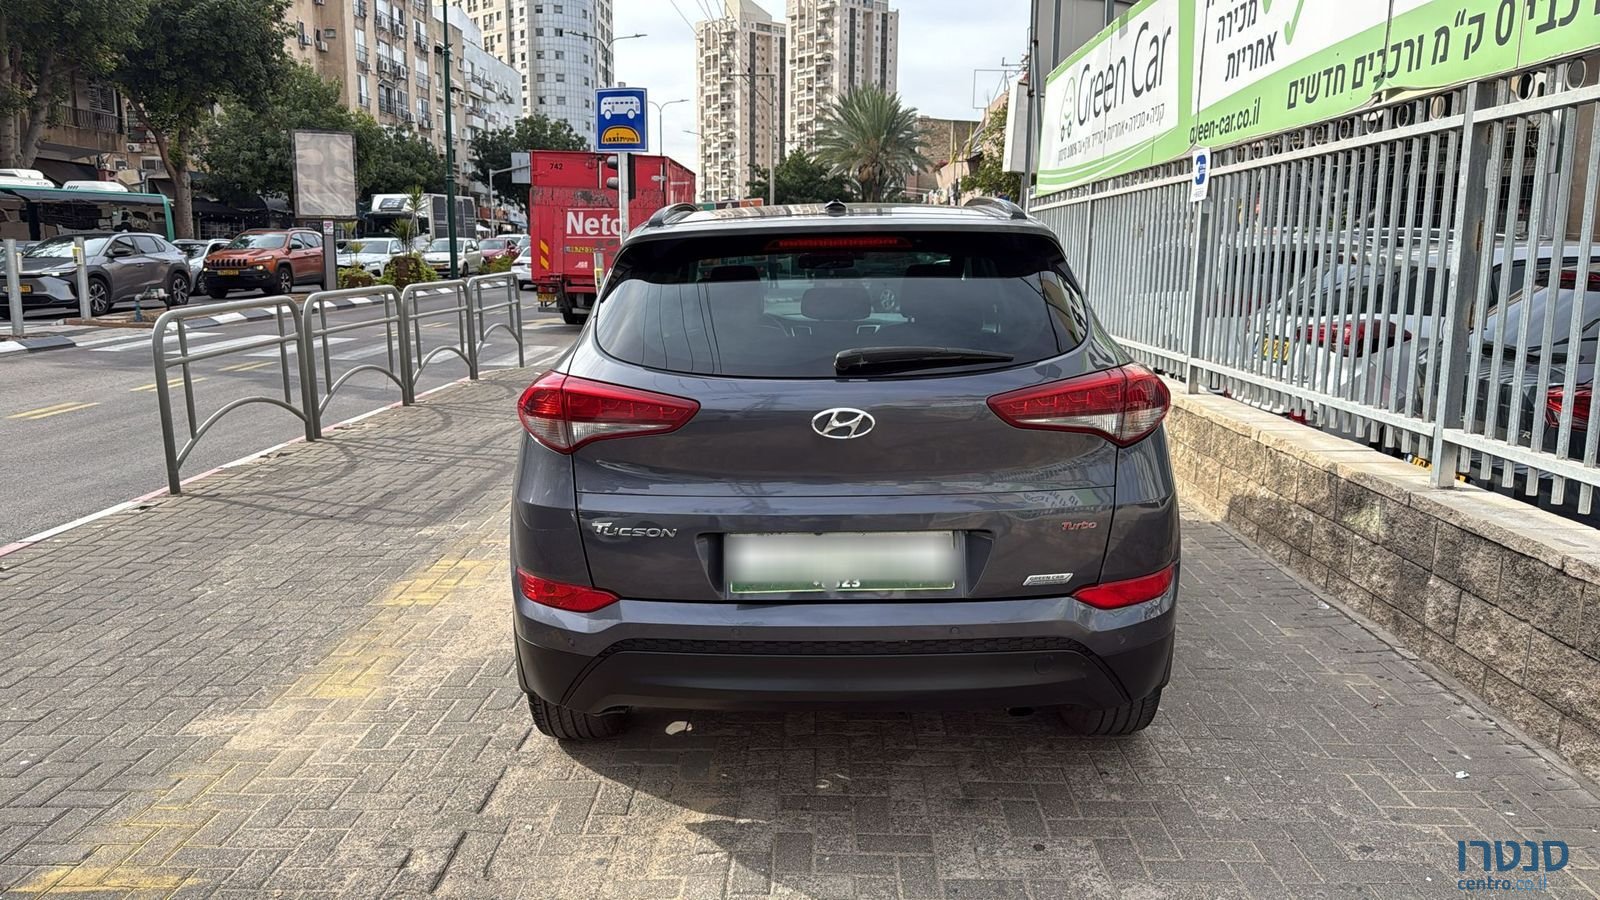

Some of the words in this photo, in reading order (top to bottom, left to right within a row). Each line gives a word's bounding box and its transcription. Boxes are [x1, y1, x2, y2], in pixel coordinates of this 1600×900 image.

[1216, 0, 1258, 44] מכירה
[1077, 56, 1126, 126] Green
[1132, 21, 1172, 98] Car
[1225, 31, 1278, 82] אחריות
[1287, 63, 1346, 110] חדשים
[549, 162, 563, 170] 742
